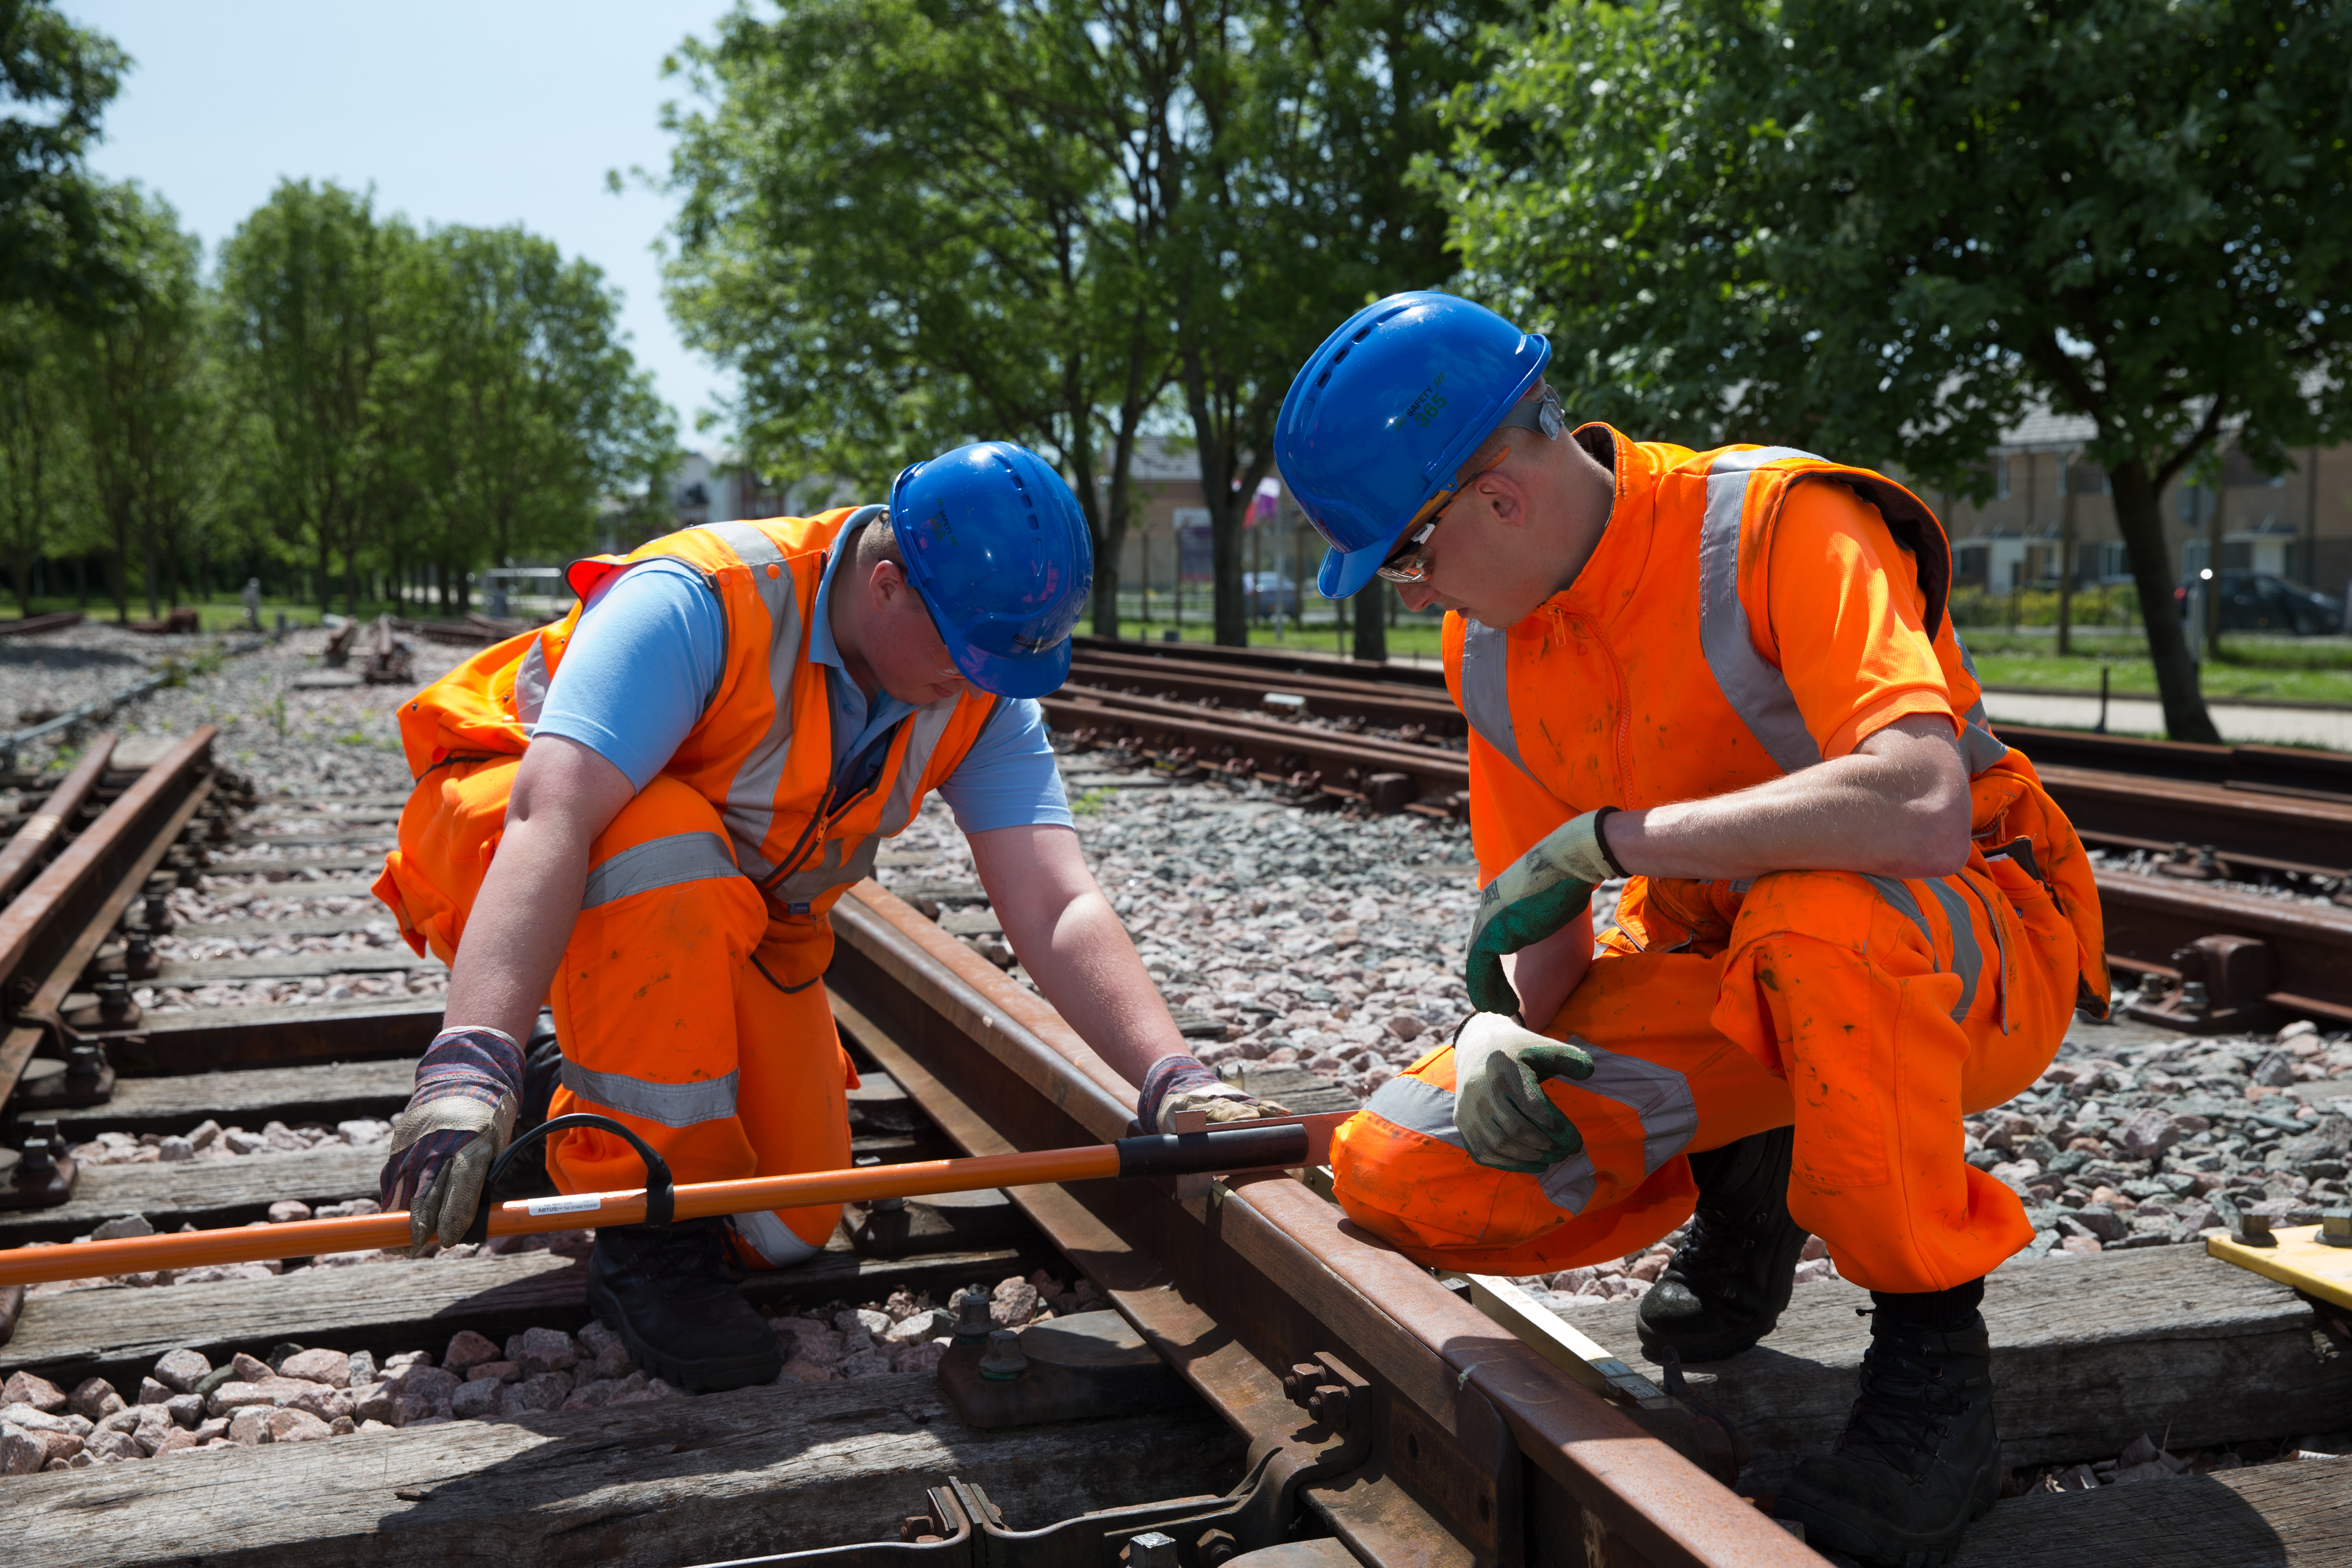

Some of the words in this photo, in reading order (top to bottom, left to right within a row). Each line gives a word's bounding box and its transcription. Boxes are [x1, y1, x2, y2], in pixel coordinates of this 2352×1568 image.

[1406, 386, 1433, 416] SAFETY
[1415, 393, 1446, 428] 365
[930, 513, 946, 541] 365
[940, 509, 953, 534] SAFETY
